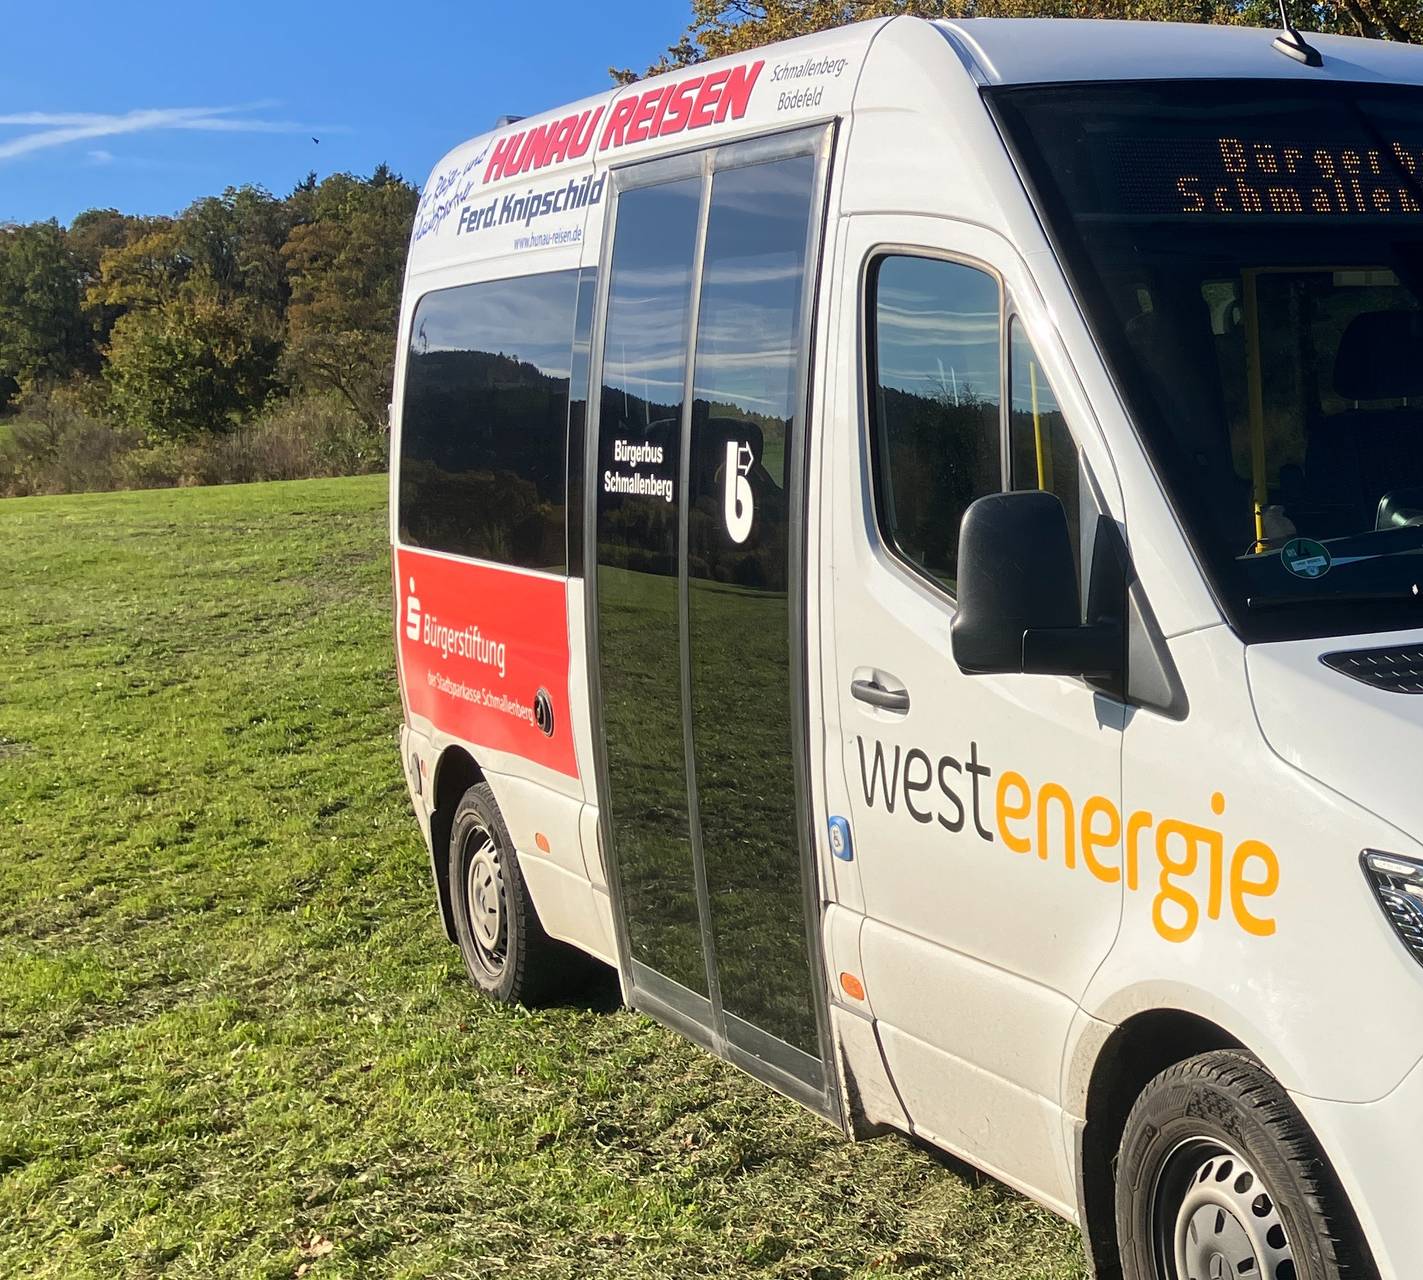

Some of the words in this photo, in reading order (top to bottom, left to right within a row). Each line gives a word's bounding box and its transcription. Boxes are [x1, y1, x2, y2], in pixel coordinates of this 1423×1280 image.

[770, 56, 848, 82] Schmallenberg-
[777, 86, 824, 111] Bödefeld
[483, 105, 605, 184] HUNAU
[599, 60, 766, 151] REISEN
[513, 225, 582, 250] www.hunau-reisen.de
[614, 439, 664, 467] Bürgerbus
[604, 470, 673, 503] Schmallenberg
[423, 613, 506, 678] Bürgerstiftung
[482, 688, 534, 726] Schmallenberg
